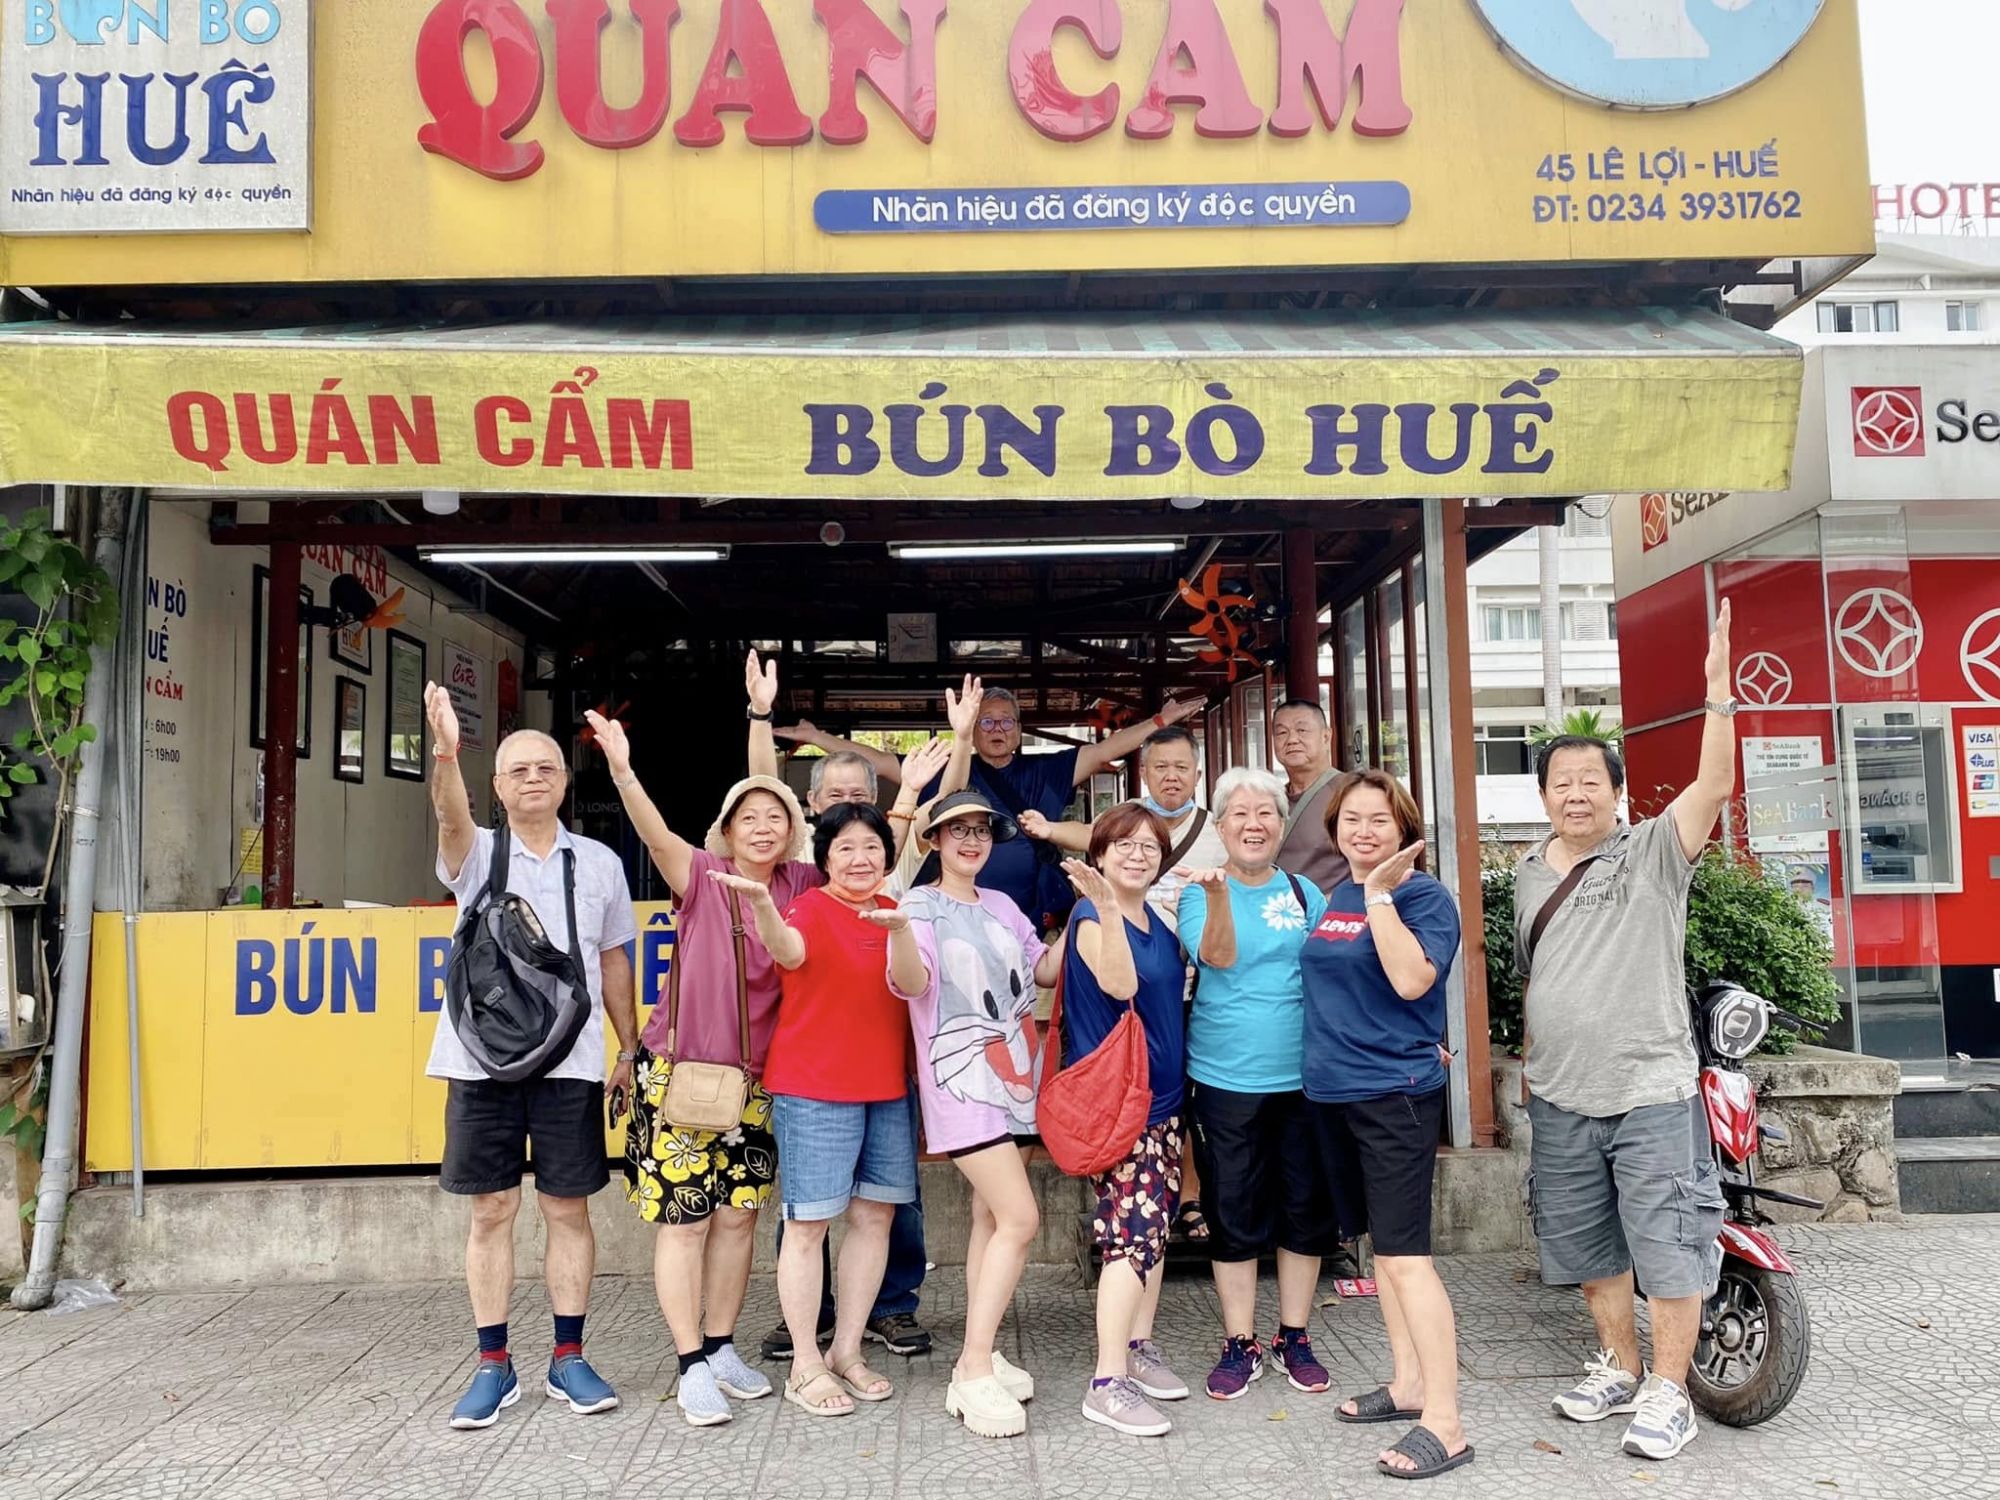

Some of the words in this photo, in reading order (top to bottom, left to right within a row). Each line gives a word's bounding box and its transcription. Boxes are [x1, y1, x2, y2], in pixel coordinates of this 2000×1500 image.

[29, 57, 276, 166] HUẾ
[1536, 153, 1576, 182] 45
[1588, 146, 1625, 180] LÊ
[1639, 146, 1687, 186] LỢI
[1713, 138, 1779, 178] HUẾ
[12, 188, 54, 202] Nhãn
[60, 187, 94, 205] hiệu
[100, 187, 123, 201] đã
[129, 187, 172, 204] đăng
[178, 186, 197, 203] ký
[204, 187, 232, 201] độc
[241, 183, 291, 202] quyền
[872, 196, 948, 222] Nhãn
[957, 195, 1017, 225] hiệu
[1025, 193, 1065, 220] đã
[1072, 193, 1150, 224] đăng
[1157, 191, 1191, 222] ký
[1199, 192, 1255, 220] độc
[1264, 184, 1356, 220] quyền
[1533, 195, 1578, 222] ĐT:
[1587, 193, 1666, 222] 0234
[1679, 190, 1802, 220] 3931762
[166, 377, 442, 471] QUÁN
[475, 366, 694, 470] CẨM
[803, 381, 1064, 477] BÚN
[1103, 381, 1265, 476] BÒ
[1303, 367, 1560, 475] HUẾ
[164, 578, 187, 618] BÒ
[147, 617, 169, 663] UẾ
[154, 670, 184, 701] CẨM
[155, 719, 177, 736] 6h00
[1968, 733, 1994, 743] VISA
[155, 747, 180, 763] 19h00
[1753, 793, 1833, 826] SeABank
[234, 921, 377, 1015] BÚN
